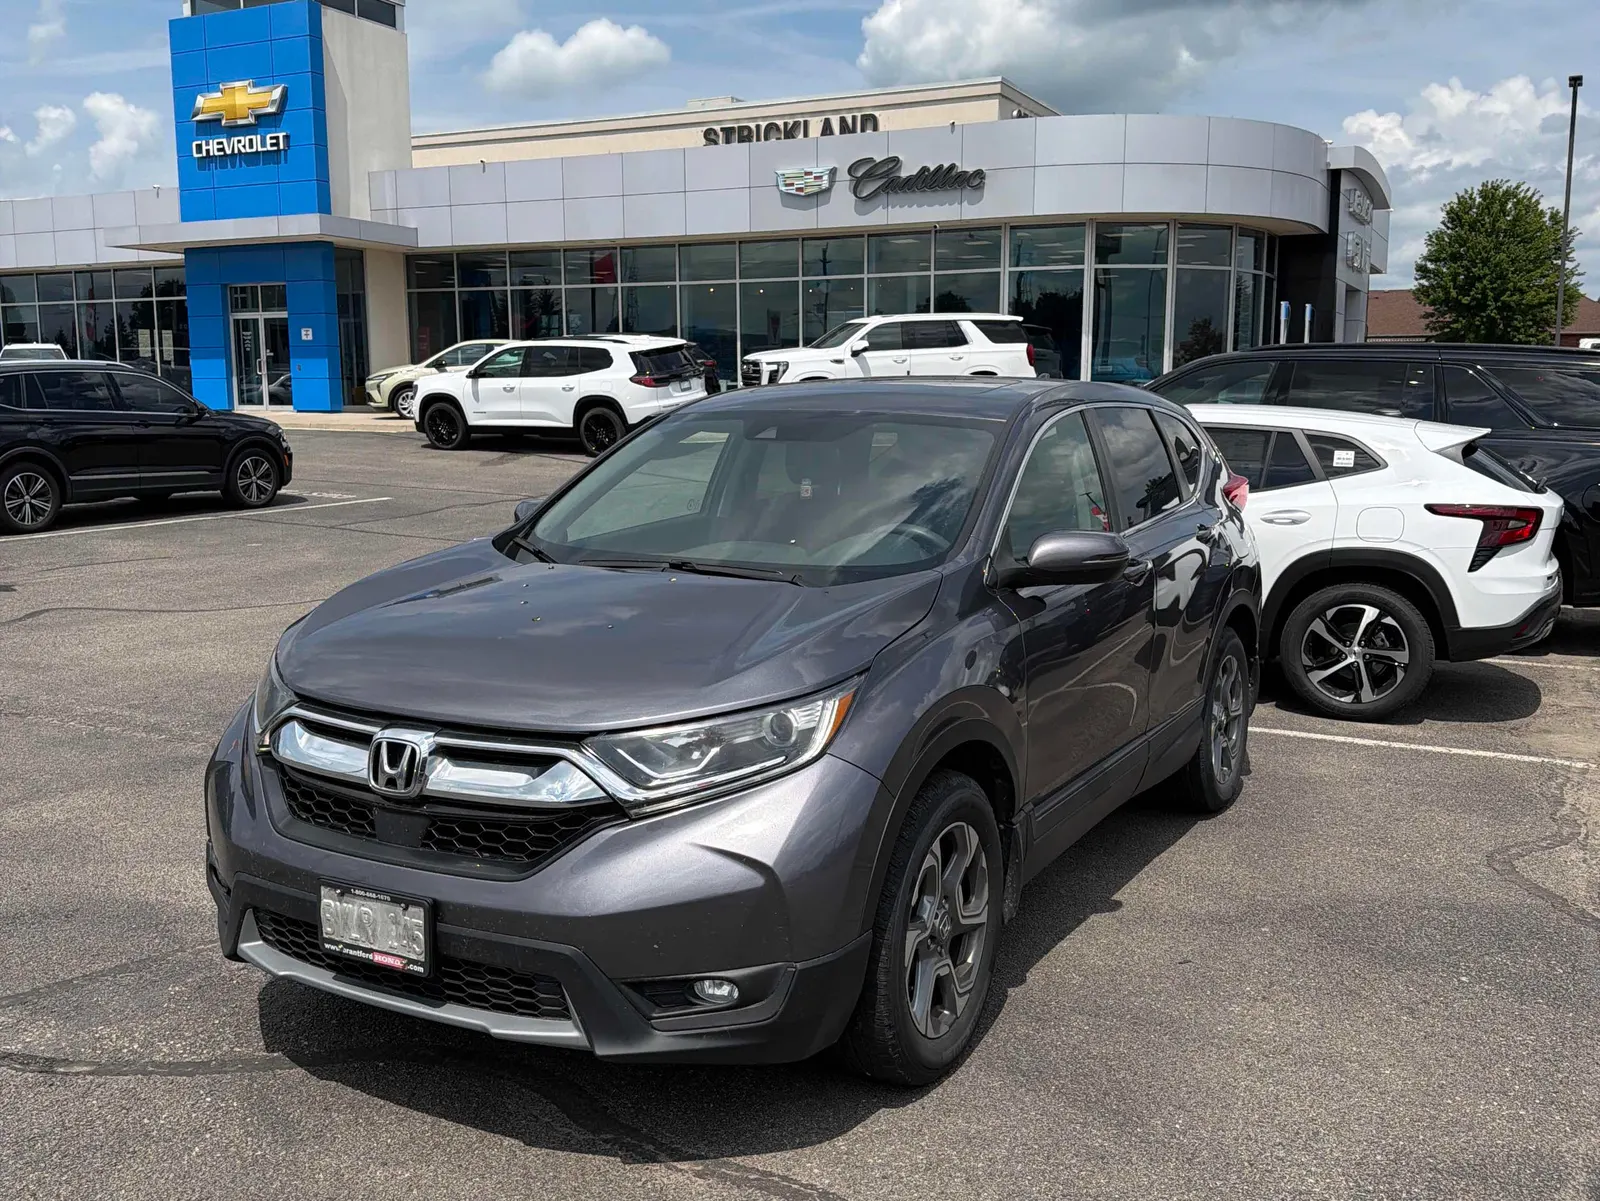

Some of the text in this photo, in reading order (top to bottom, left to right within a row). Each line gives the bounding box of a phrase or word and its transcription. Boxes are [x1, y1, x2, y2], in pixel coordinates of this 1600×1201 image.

[192, 132, 288, 158] CHEVROLET
[703, 113, 879, 146] STRICKLAND
[847, 156, 985, 200] Cadillac
